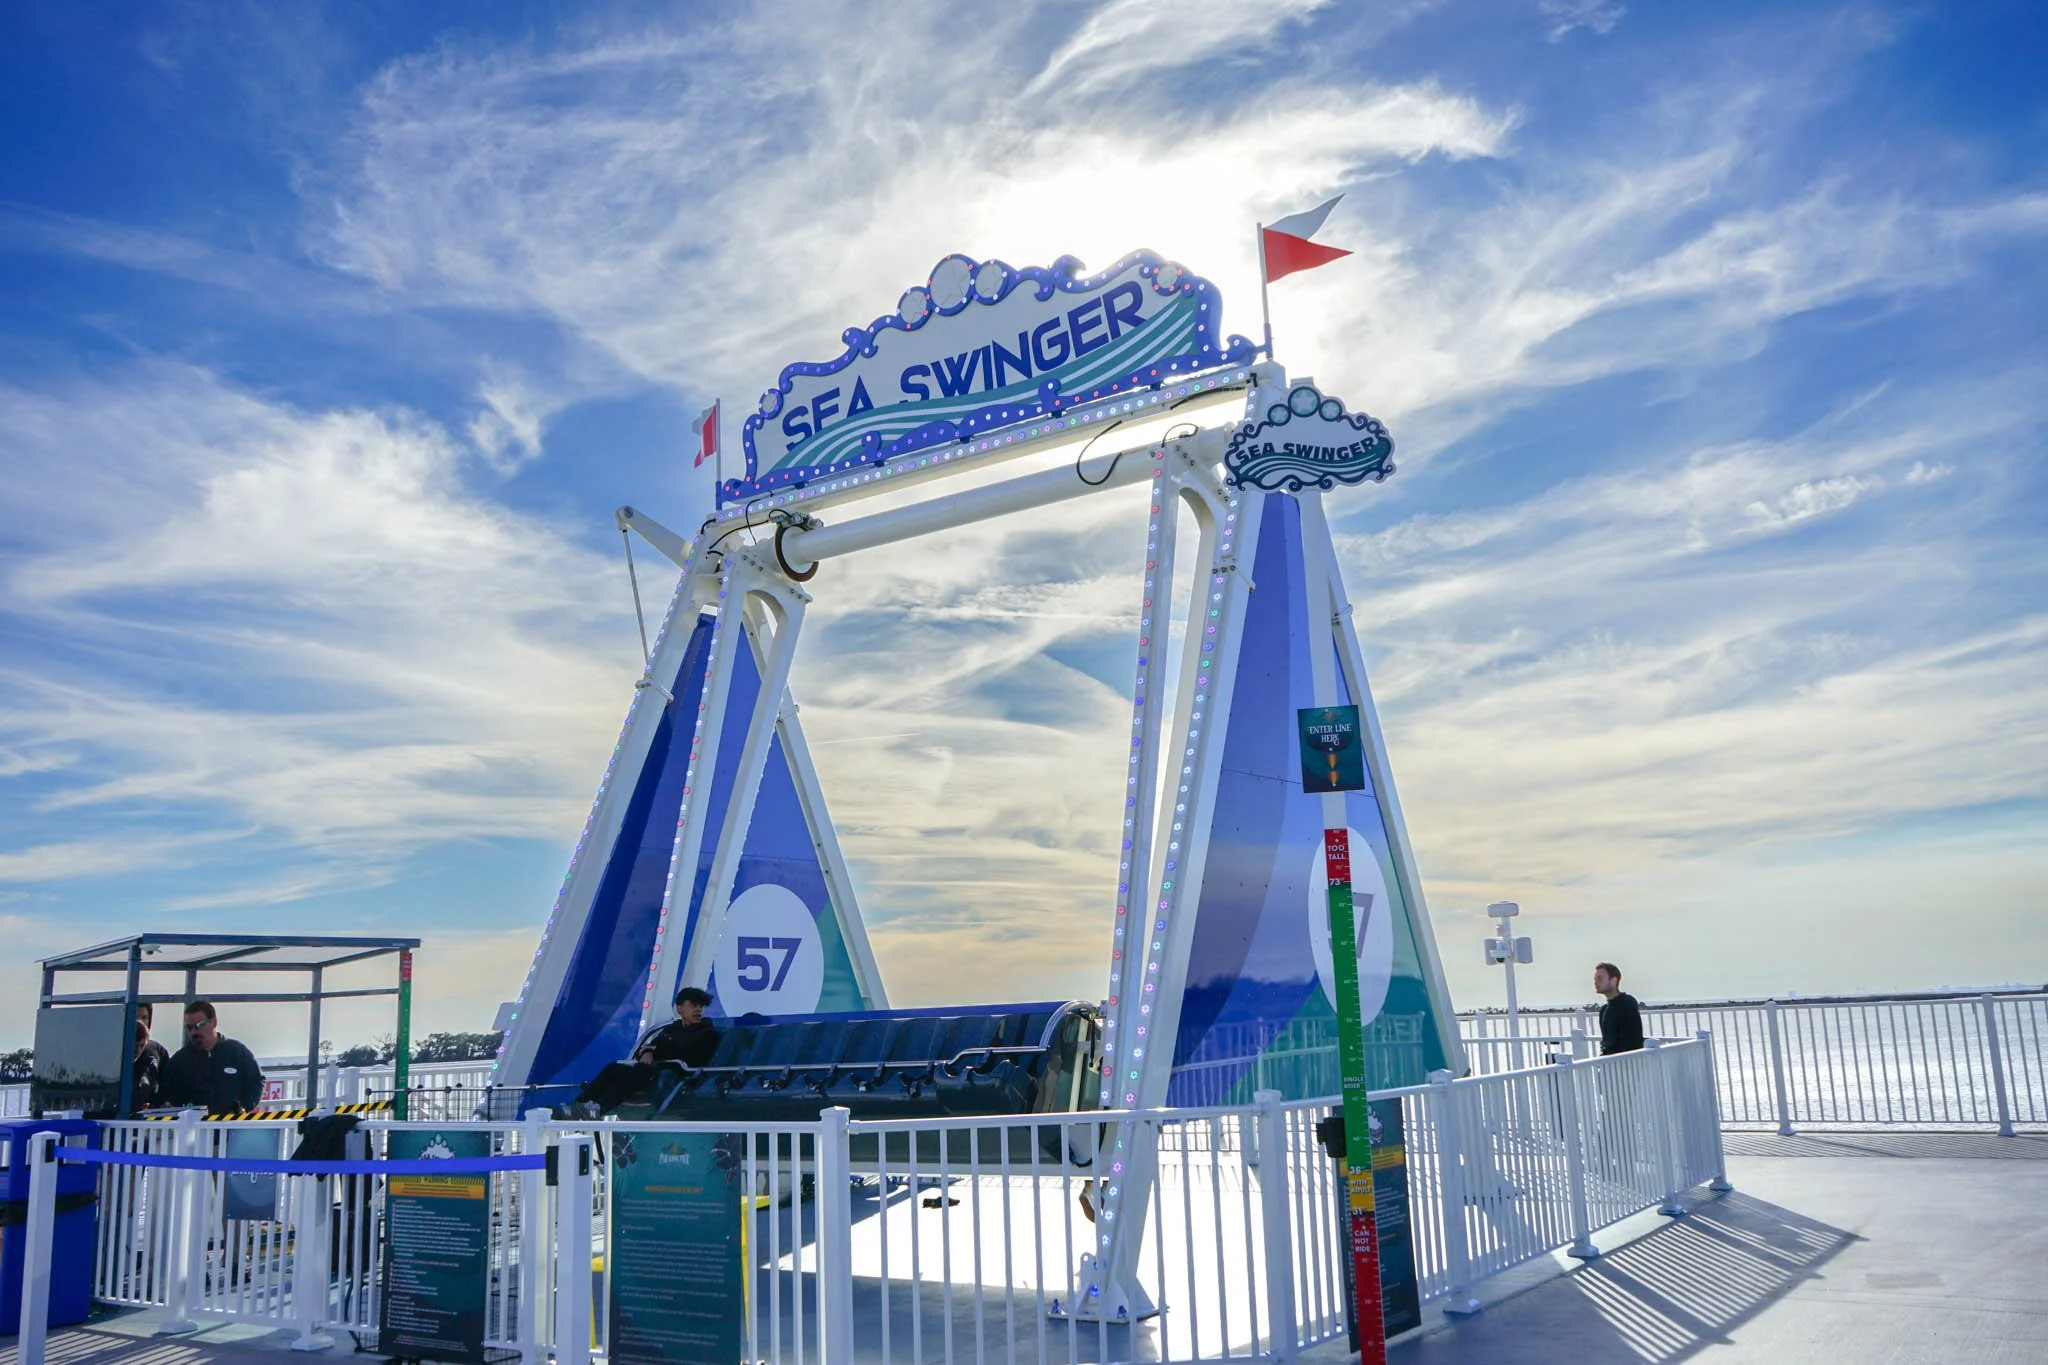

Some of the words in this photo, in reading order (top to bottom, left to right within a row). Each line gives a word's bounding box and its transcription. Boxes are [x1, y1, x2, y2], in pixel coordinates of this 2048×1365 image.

[783, 375, 875, 450] SEA
[900, 280, 1147, 402] SWINGER
[1235, 442, 1276, 464] SEA
[1282, 437, 1377, 461] SWINGER
[1307, 725, 1333, 735] ENTER
[1335, 723, 1352, 733] LINE
[1321, 734, 1340, 746] HERE
[737, 936, 803, 992] 57
